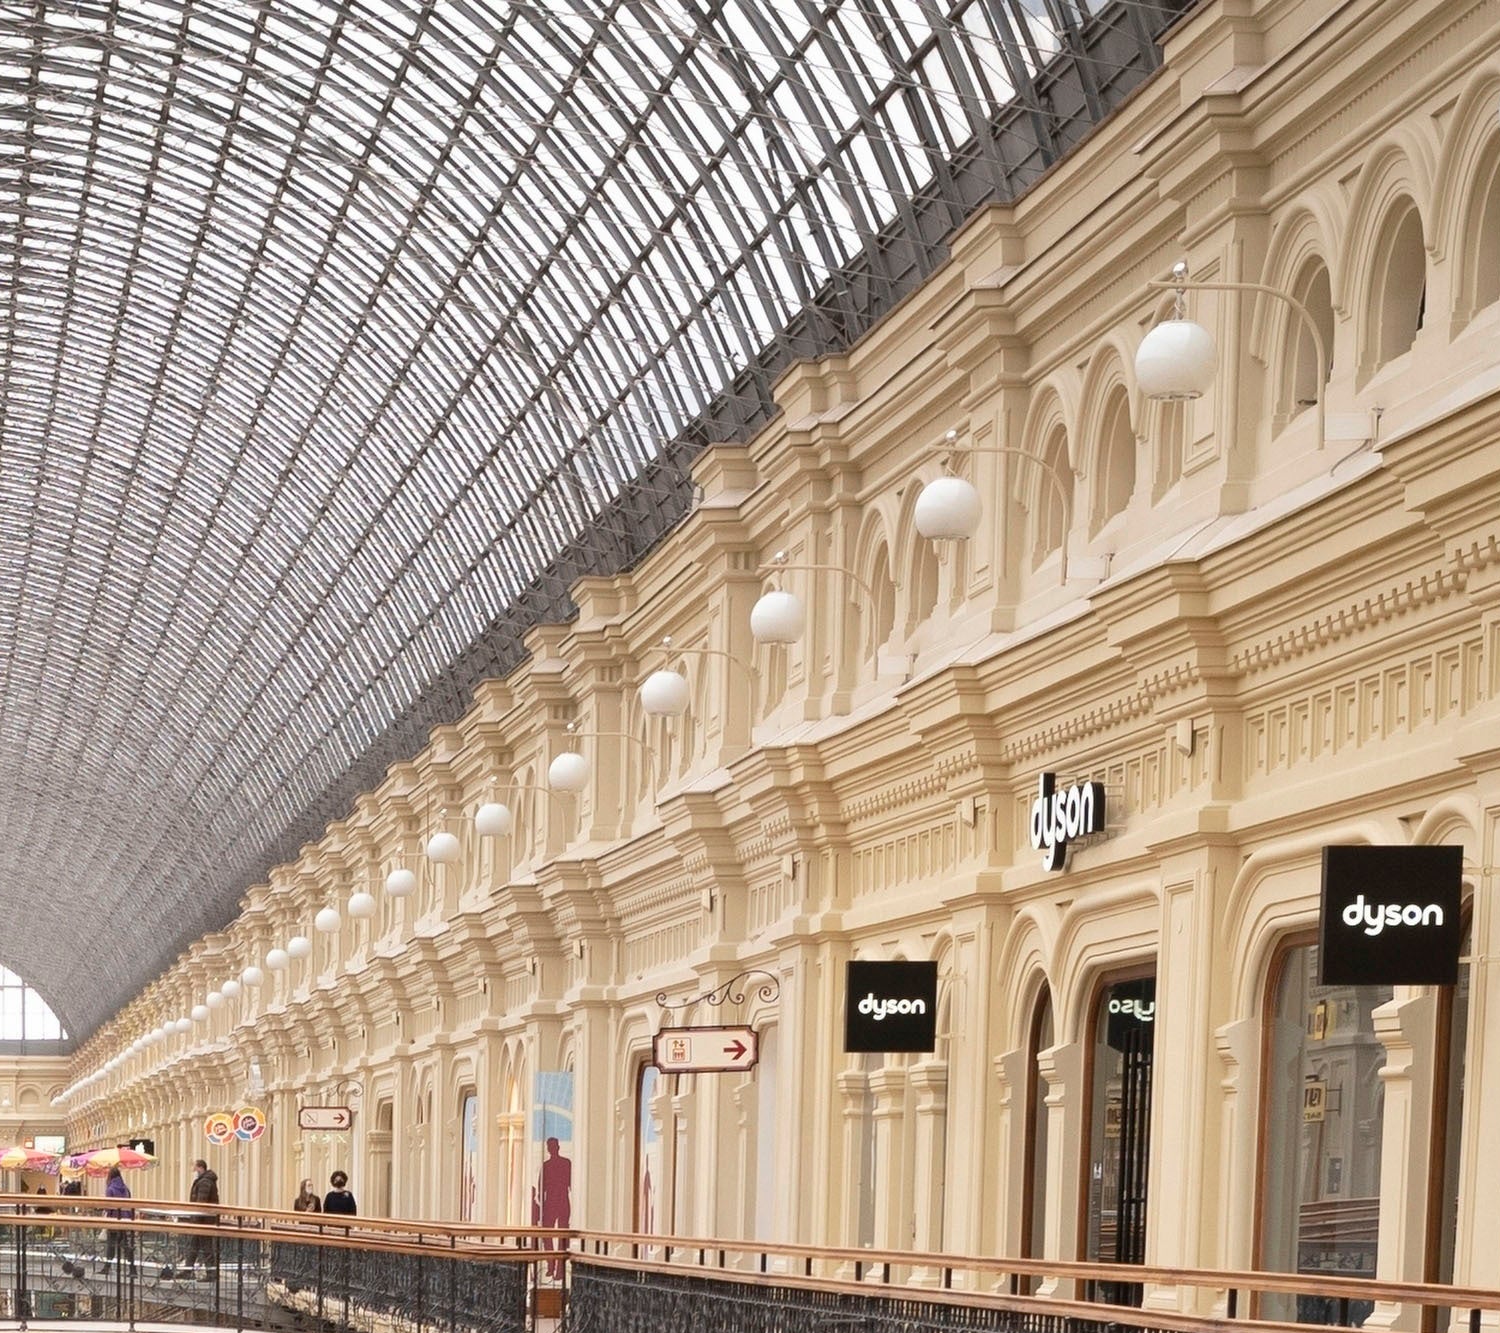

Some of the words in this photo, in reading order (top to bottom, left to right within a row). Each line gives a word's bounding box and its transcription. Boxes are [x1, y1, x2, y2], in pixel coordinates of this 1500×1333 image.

[1030, 773, 1105, 871] dyson
[1342, 894, 1444, 937] dyson
[858, 993, 926, 1021] dyson
